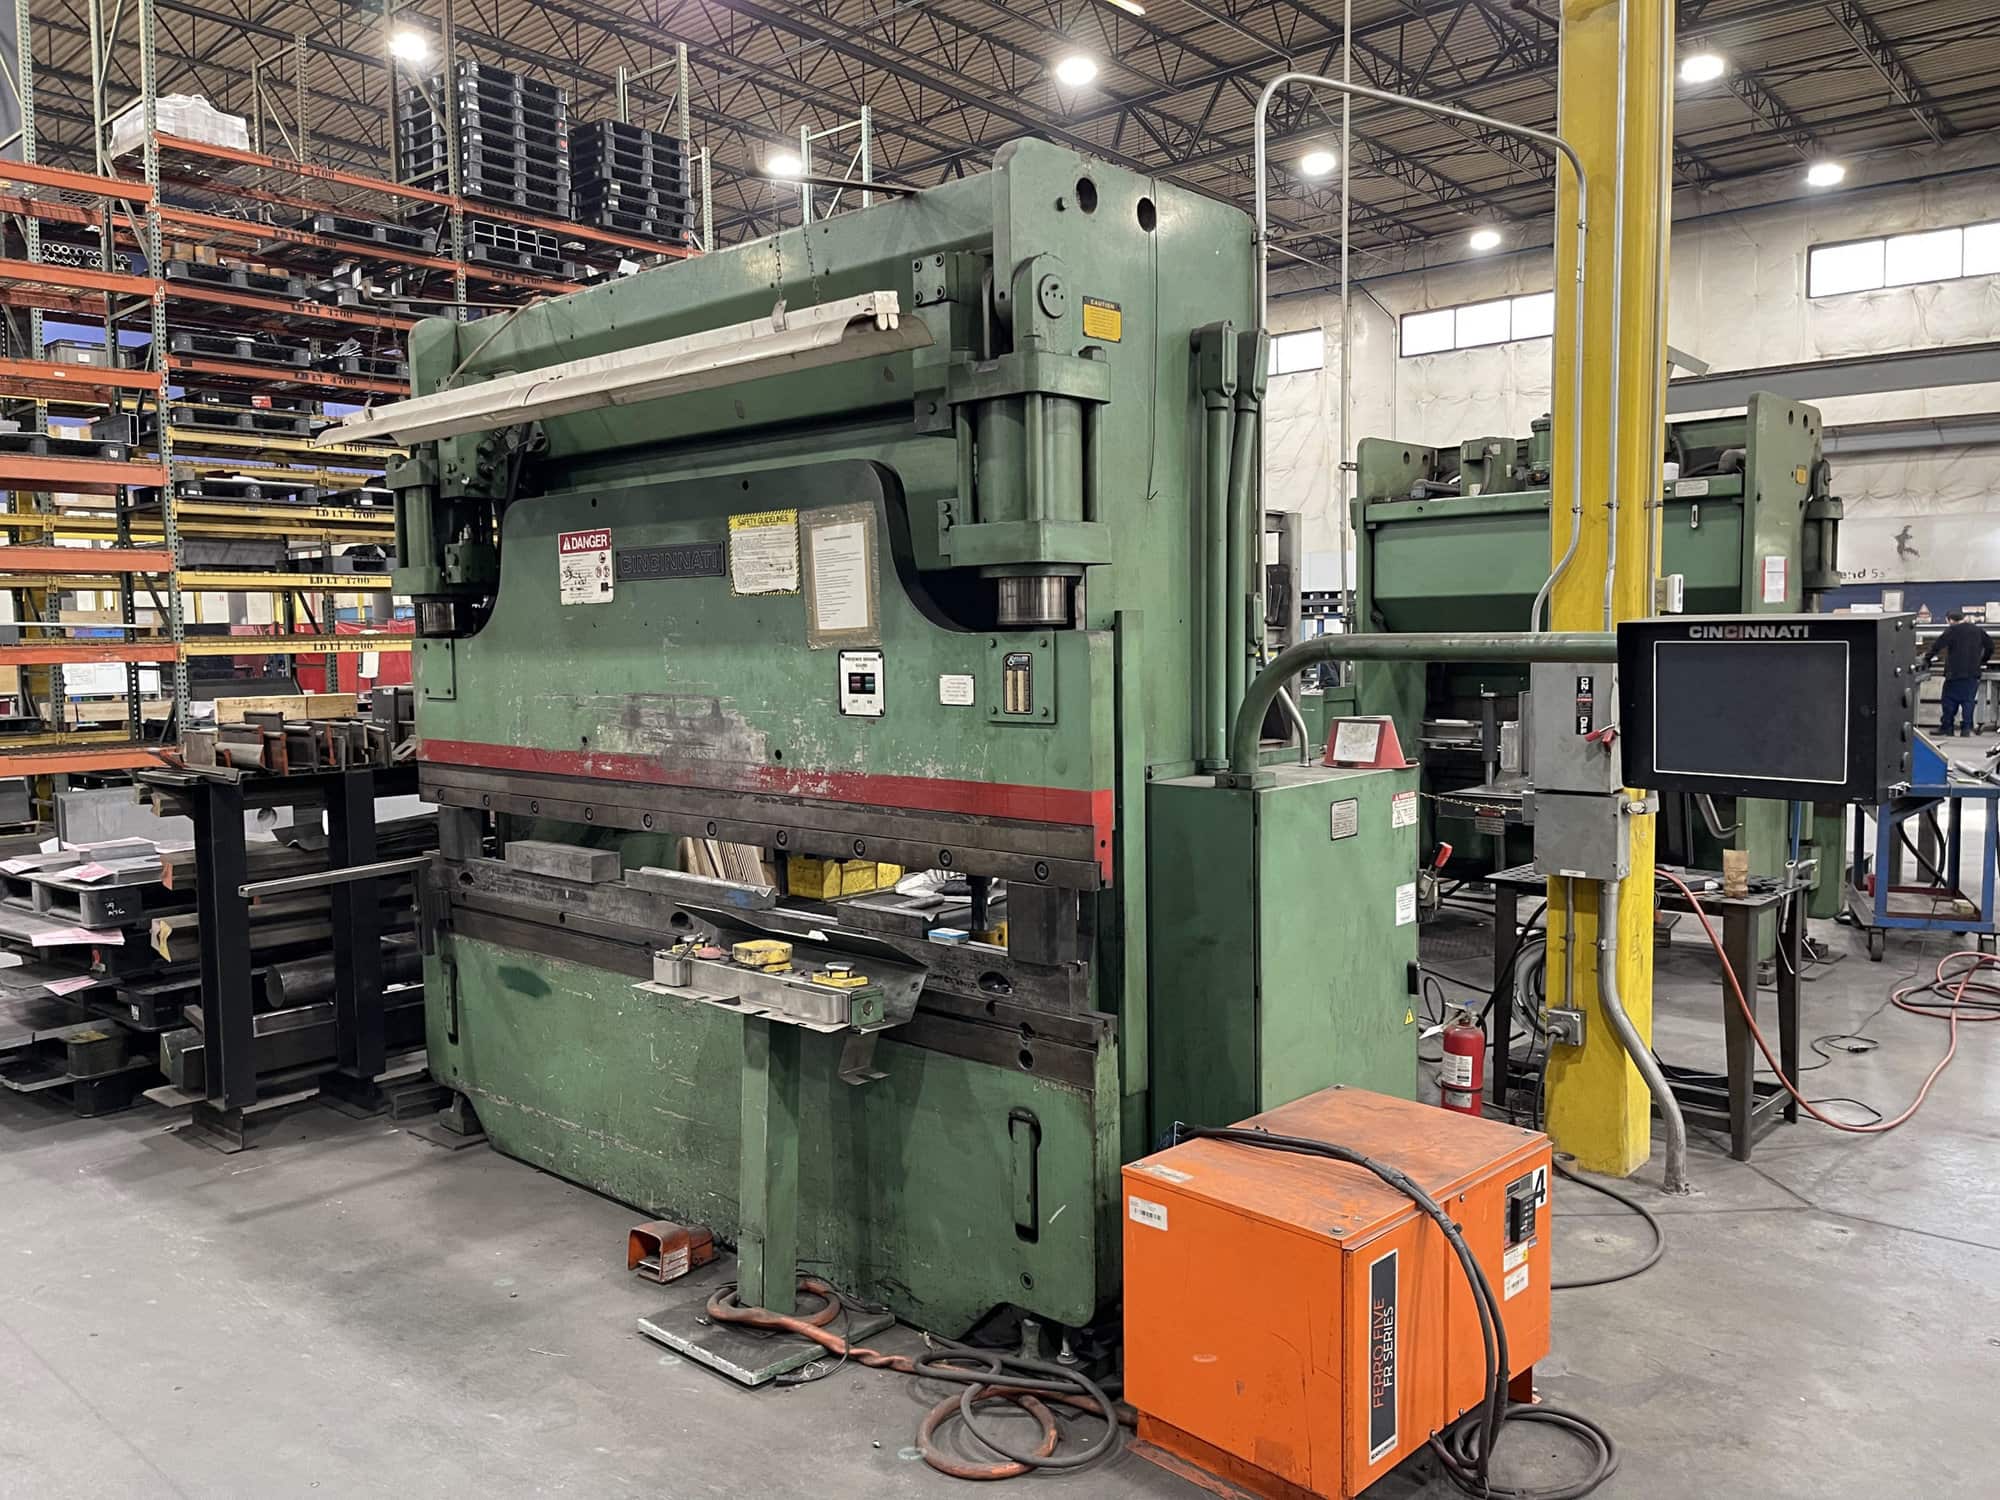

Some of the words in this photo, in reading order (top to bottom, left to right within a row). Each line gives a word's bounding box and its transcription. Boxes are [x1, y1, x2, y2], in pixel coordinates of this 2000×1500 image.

[571, 533, 608, 550] DANGER
[621, 549, 718, 575] CINCINNATI
[1689, 625, 1809, 639] CINCINNATI
[1534, 1168, 1547, 1204] 4
[1373, 1297, 1385, 1340] FIVE
[1383, 1306, 1394, 1361] SERIES
[1373, 1344, 1385, 1409] FERRO
[1383, 1364, 1394, 1388] FR
